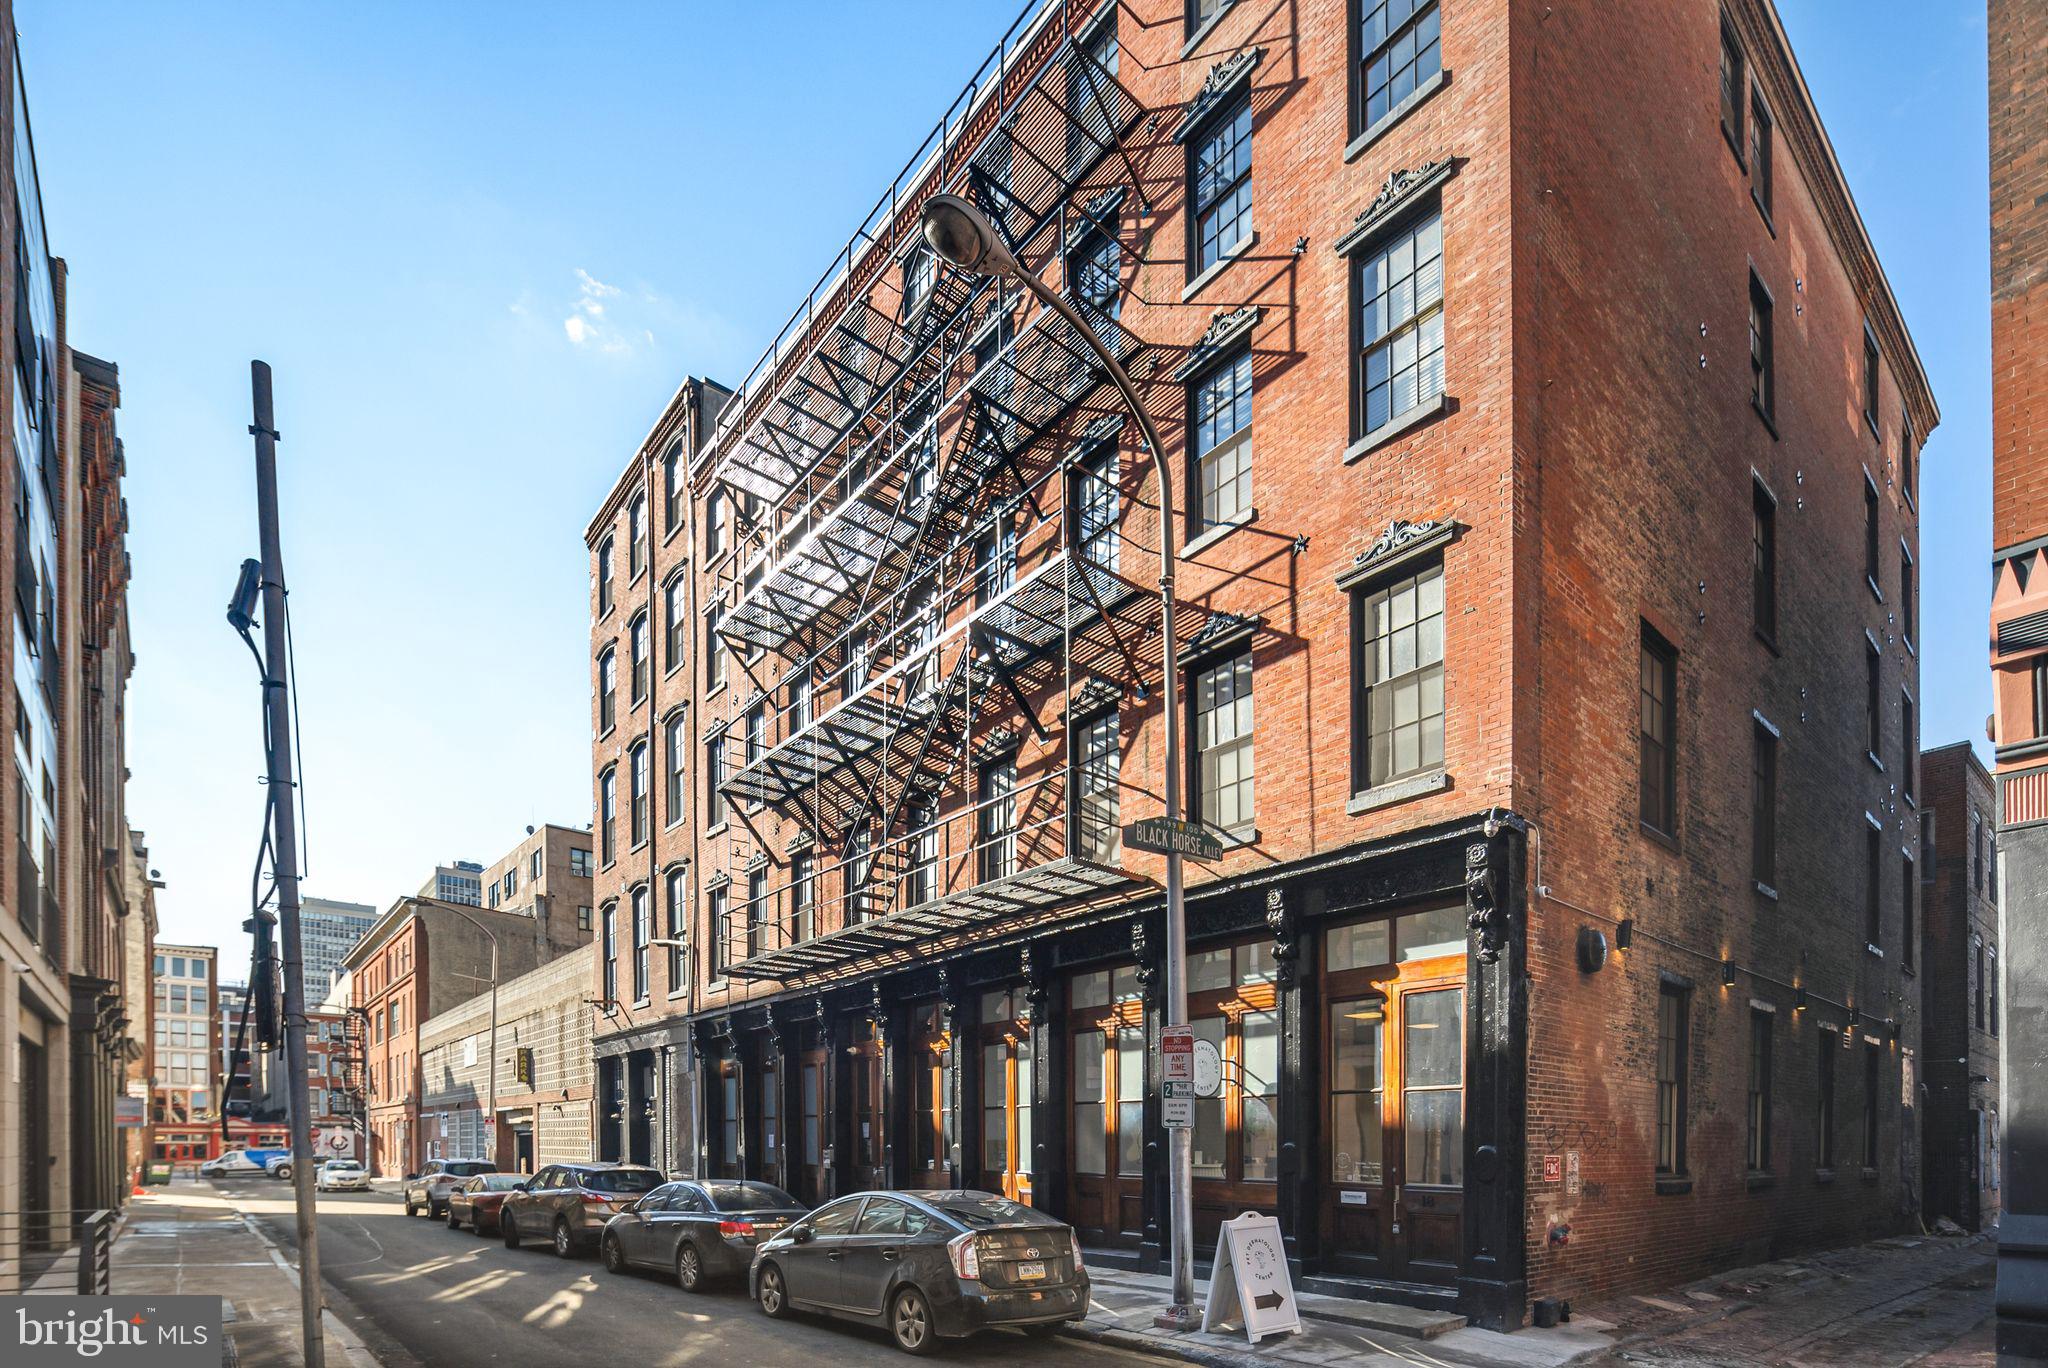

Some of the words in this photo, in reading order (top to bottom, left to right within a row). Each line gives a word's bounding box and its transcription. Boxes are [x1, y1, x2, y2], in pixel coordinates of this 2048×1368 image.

[1136, 824, 1168, 847] BLACK
[1172, 831, 1202, 855] HORSE
[1203, 845, 1223, 861] ALLEY
[1164, 1044, 1191, 1052] STOPPING
[1170, 1063, 1186, 1071] TIME
[1165, 1084, 1171, 1096] 2
[1255, 1272, 1273, 1280] CENTER
